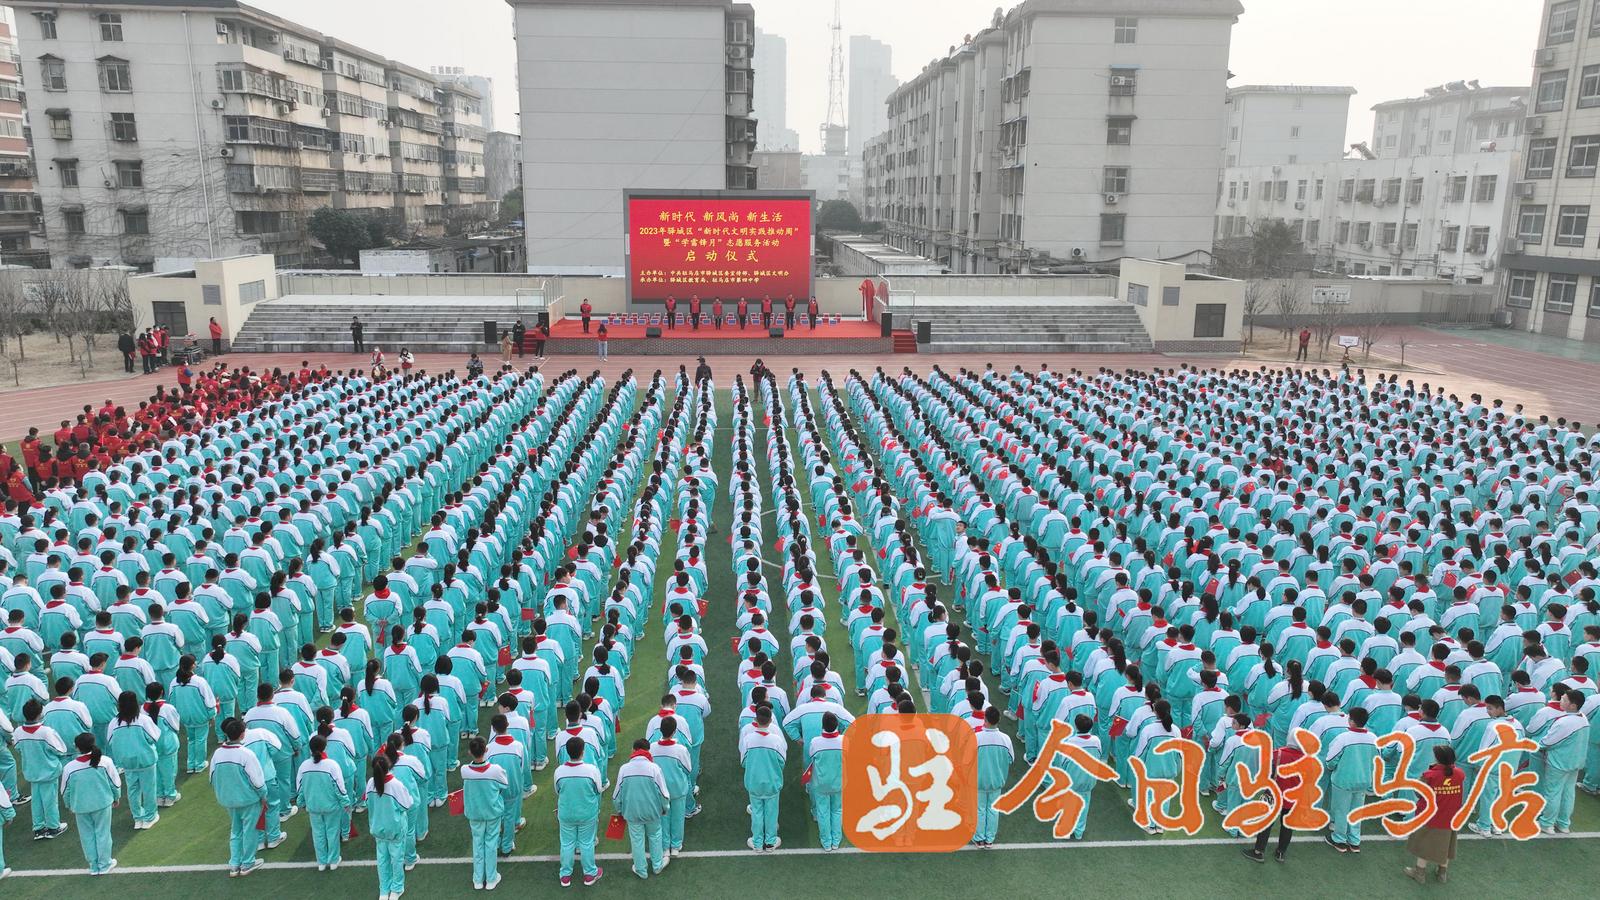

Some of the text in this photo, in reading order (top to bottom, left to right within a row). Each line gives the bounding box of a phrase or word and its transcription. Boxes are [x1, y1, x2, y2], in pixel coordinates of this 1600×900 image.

[659, 210, 783, 222] 新时代 新风尚 新生活
[685, 249, 759, 263] 启动仪式
